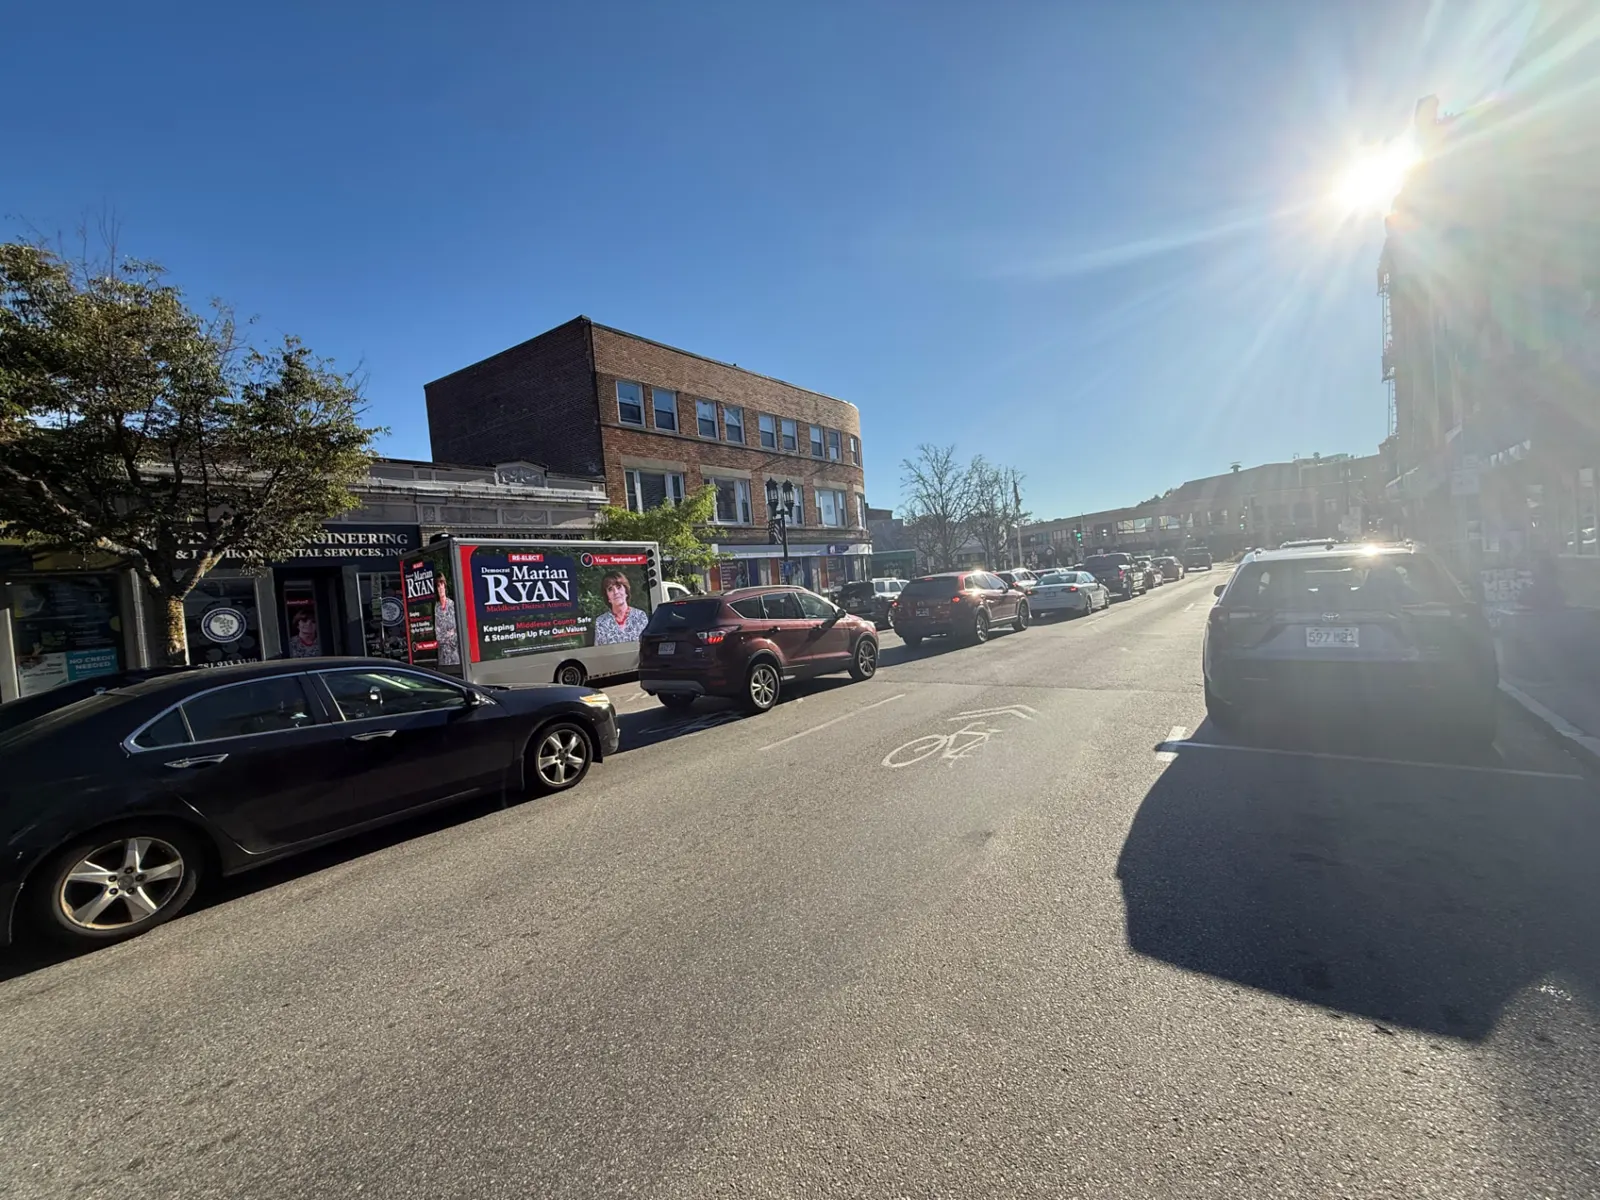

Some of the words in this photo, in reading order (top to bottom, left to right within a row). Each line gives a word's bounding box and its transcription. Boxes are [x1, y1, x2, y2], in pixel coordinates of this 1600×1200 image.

[295, 532, 408, 545] NGINEERING
[175, 550, 188, 559] &
[324, 548, 384, 557] SERVICES,
[414, 569, 433, 581] Marian
[511, 565, 569, 580] Marian
[406, 578, 434, 599] RYAN
[481, 574, 570, 605] RYAN
[483, 624, 515, 633] Keeping
[516, 620, 551, 629] Middlesex
[492, 632, 526, 642] Standing
[526, 631, 538, 639] Up
[85, 655, 114, 663] CREDIT
[75, 661, 111, 670] NEEDED
